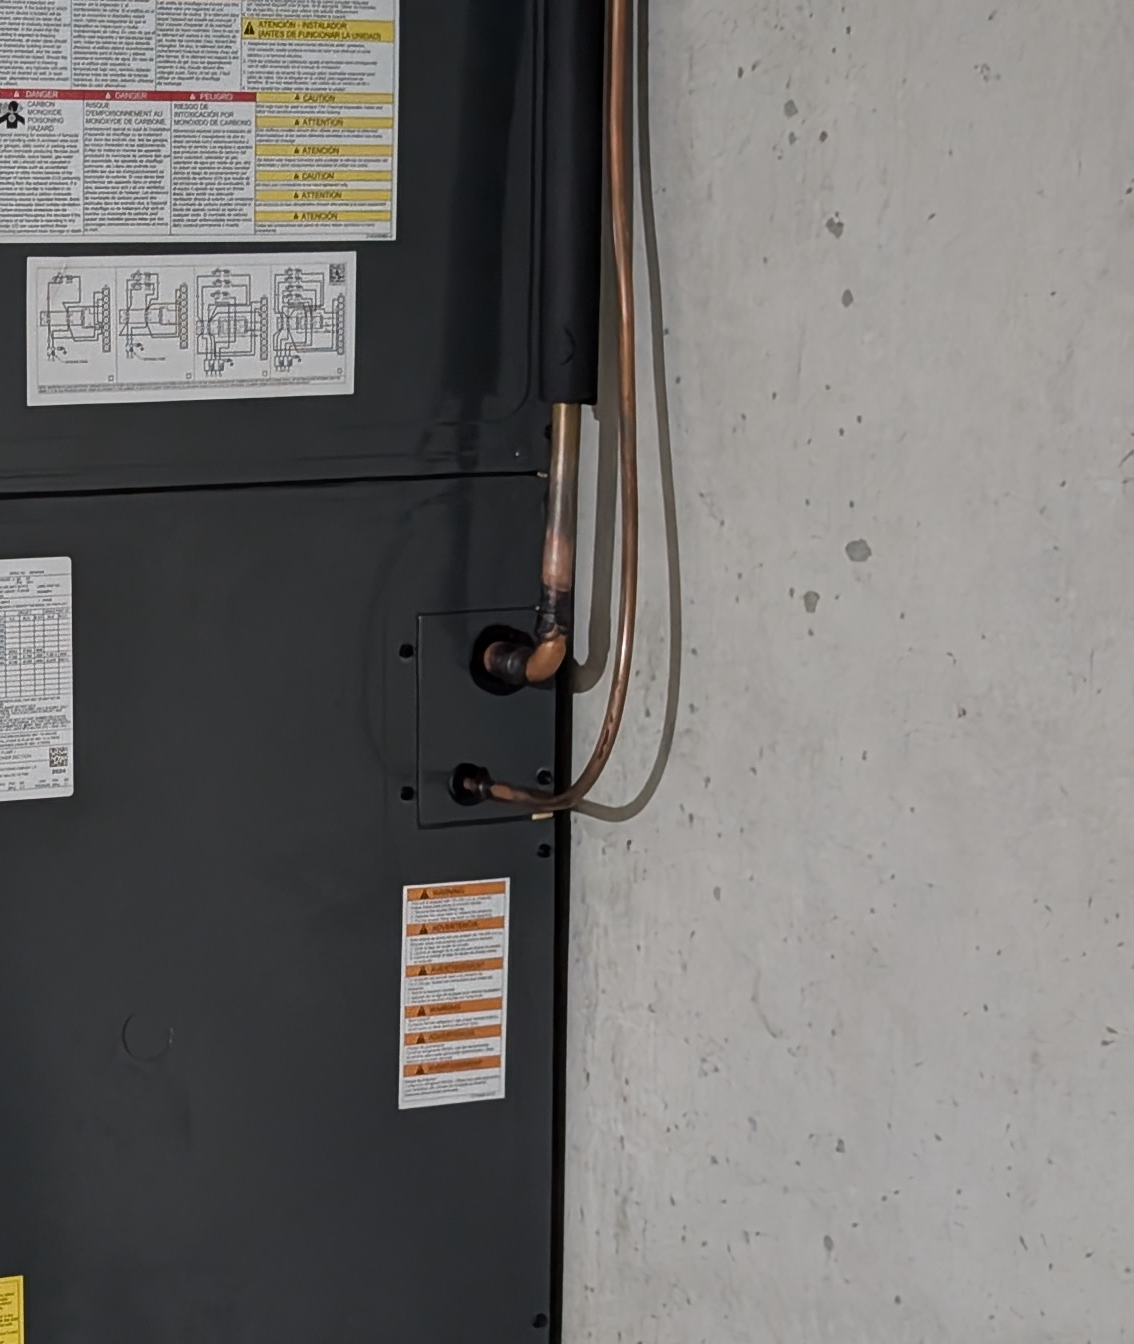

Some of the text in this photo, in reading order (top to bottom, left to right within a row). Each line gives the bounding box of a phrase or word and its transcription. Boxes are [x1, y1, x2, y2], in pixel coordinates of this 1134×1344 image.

[302, 22, 347, 31] INSTALADOR
[286, 31, 296, 39] DE
[298, 31, 340, 40] FUNCIONAR
[342, 32, 350, 40] LA
[26, 90, 58, 98] DANGER
[303, 94, 335, 102] CAUTION
[303, 118, 343, 126] ATTENTION
[302, 172, 335, 180] CAUTION
[302, 191, 342, 199] ATTENTION
